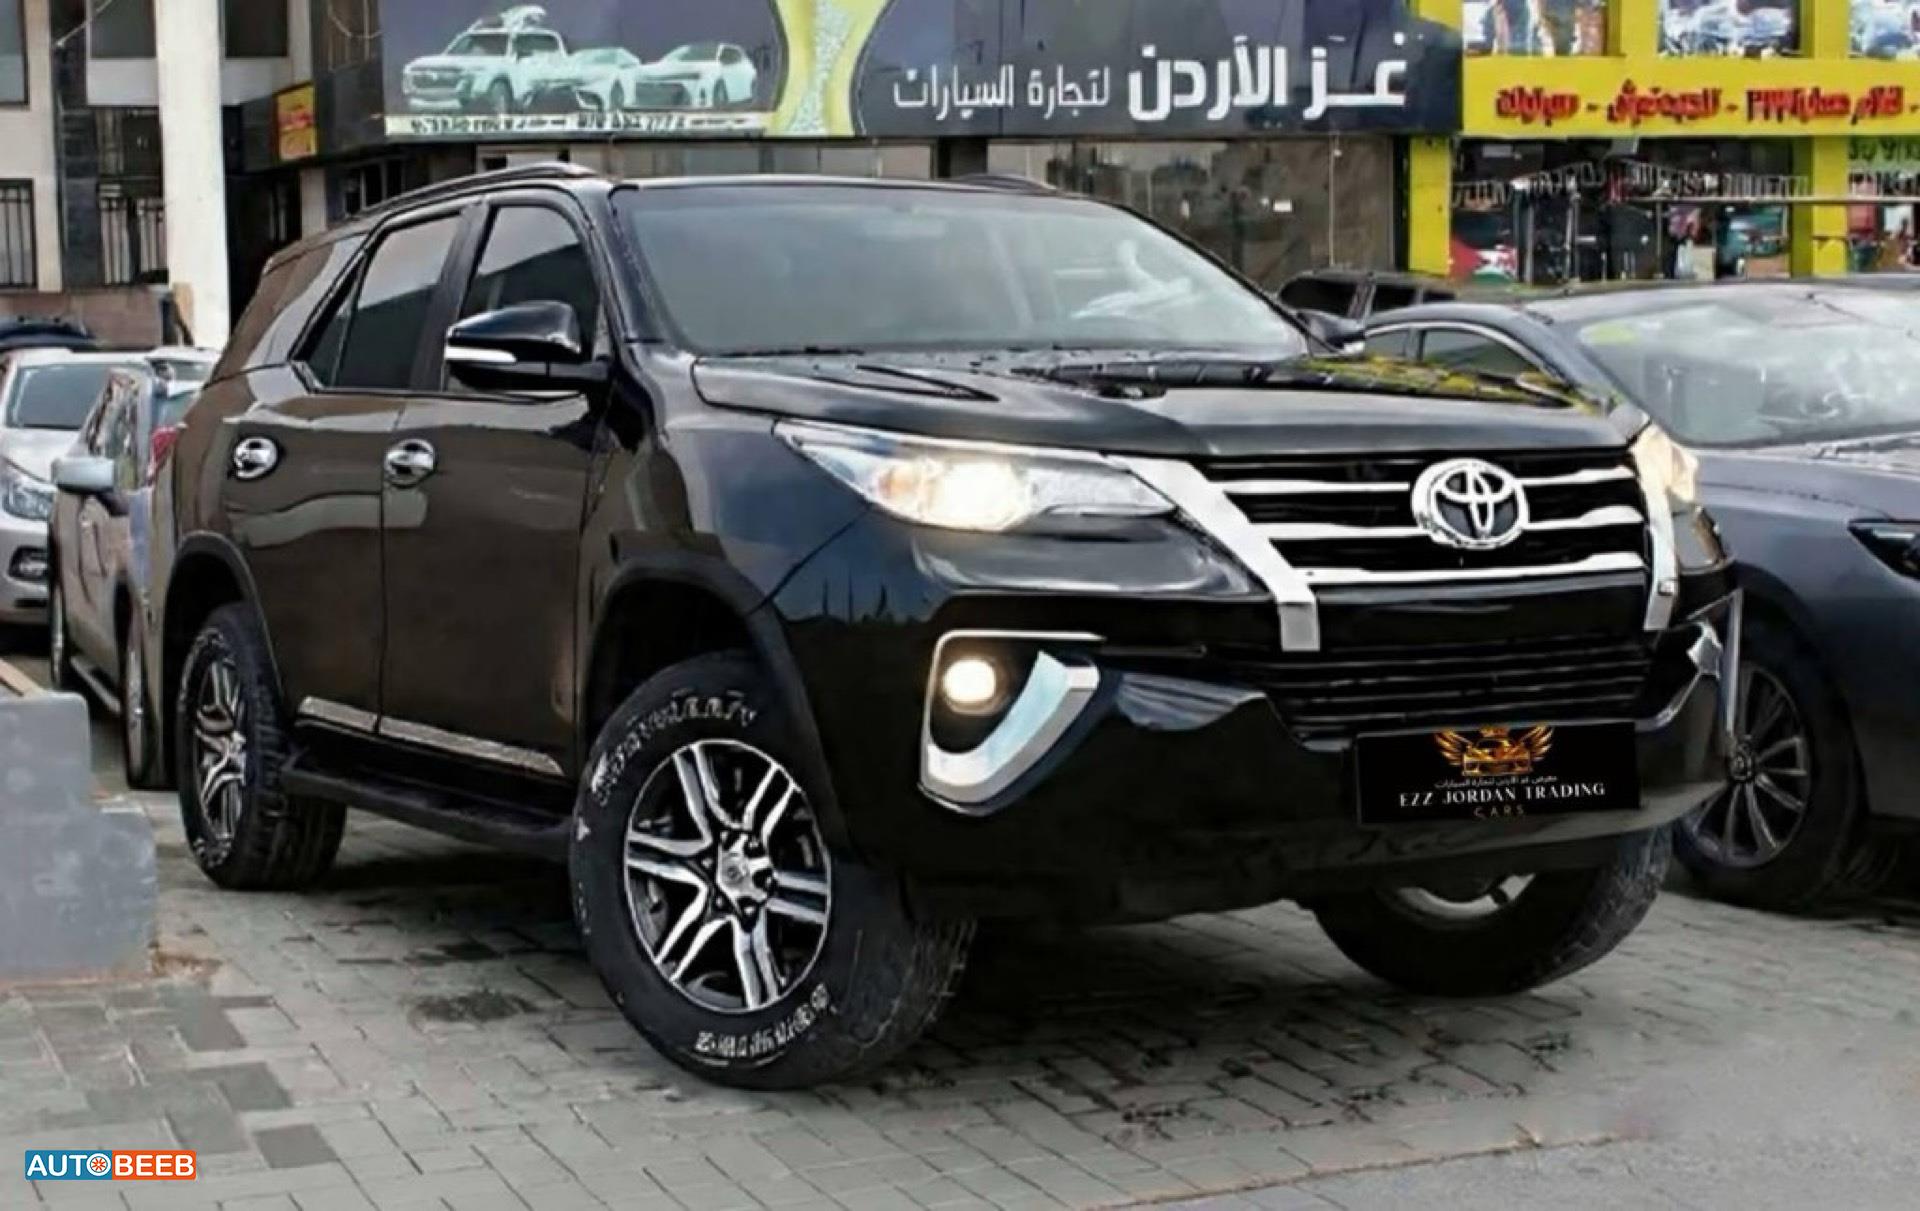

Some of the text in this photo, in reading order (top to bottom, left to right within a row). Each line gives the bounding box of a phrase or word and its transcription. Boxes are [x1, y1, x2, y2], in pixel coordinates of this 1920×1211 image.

[893, 64, 1015, 121] السيارات
[1128, 35, 1289, 121] الأردن
[1400, 781, 1606, 807] EZZ JORDAN TRADING
[1473, 804, 1525, 818] CARS
